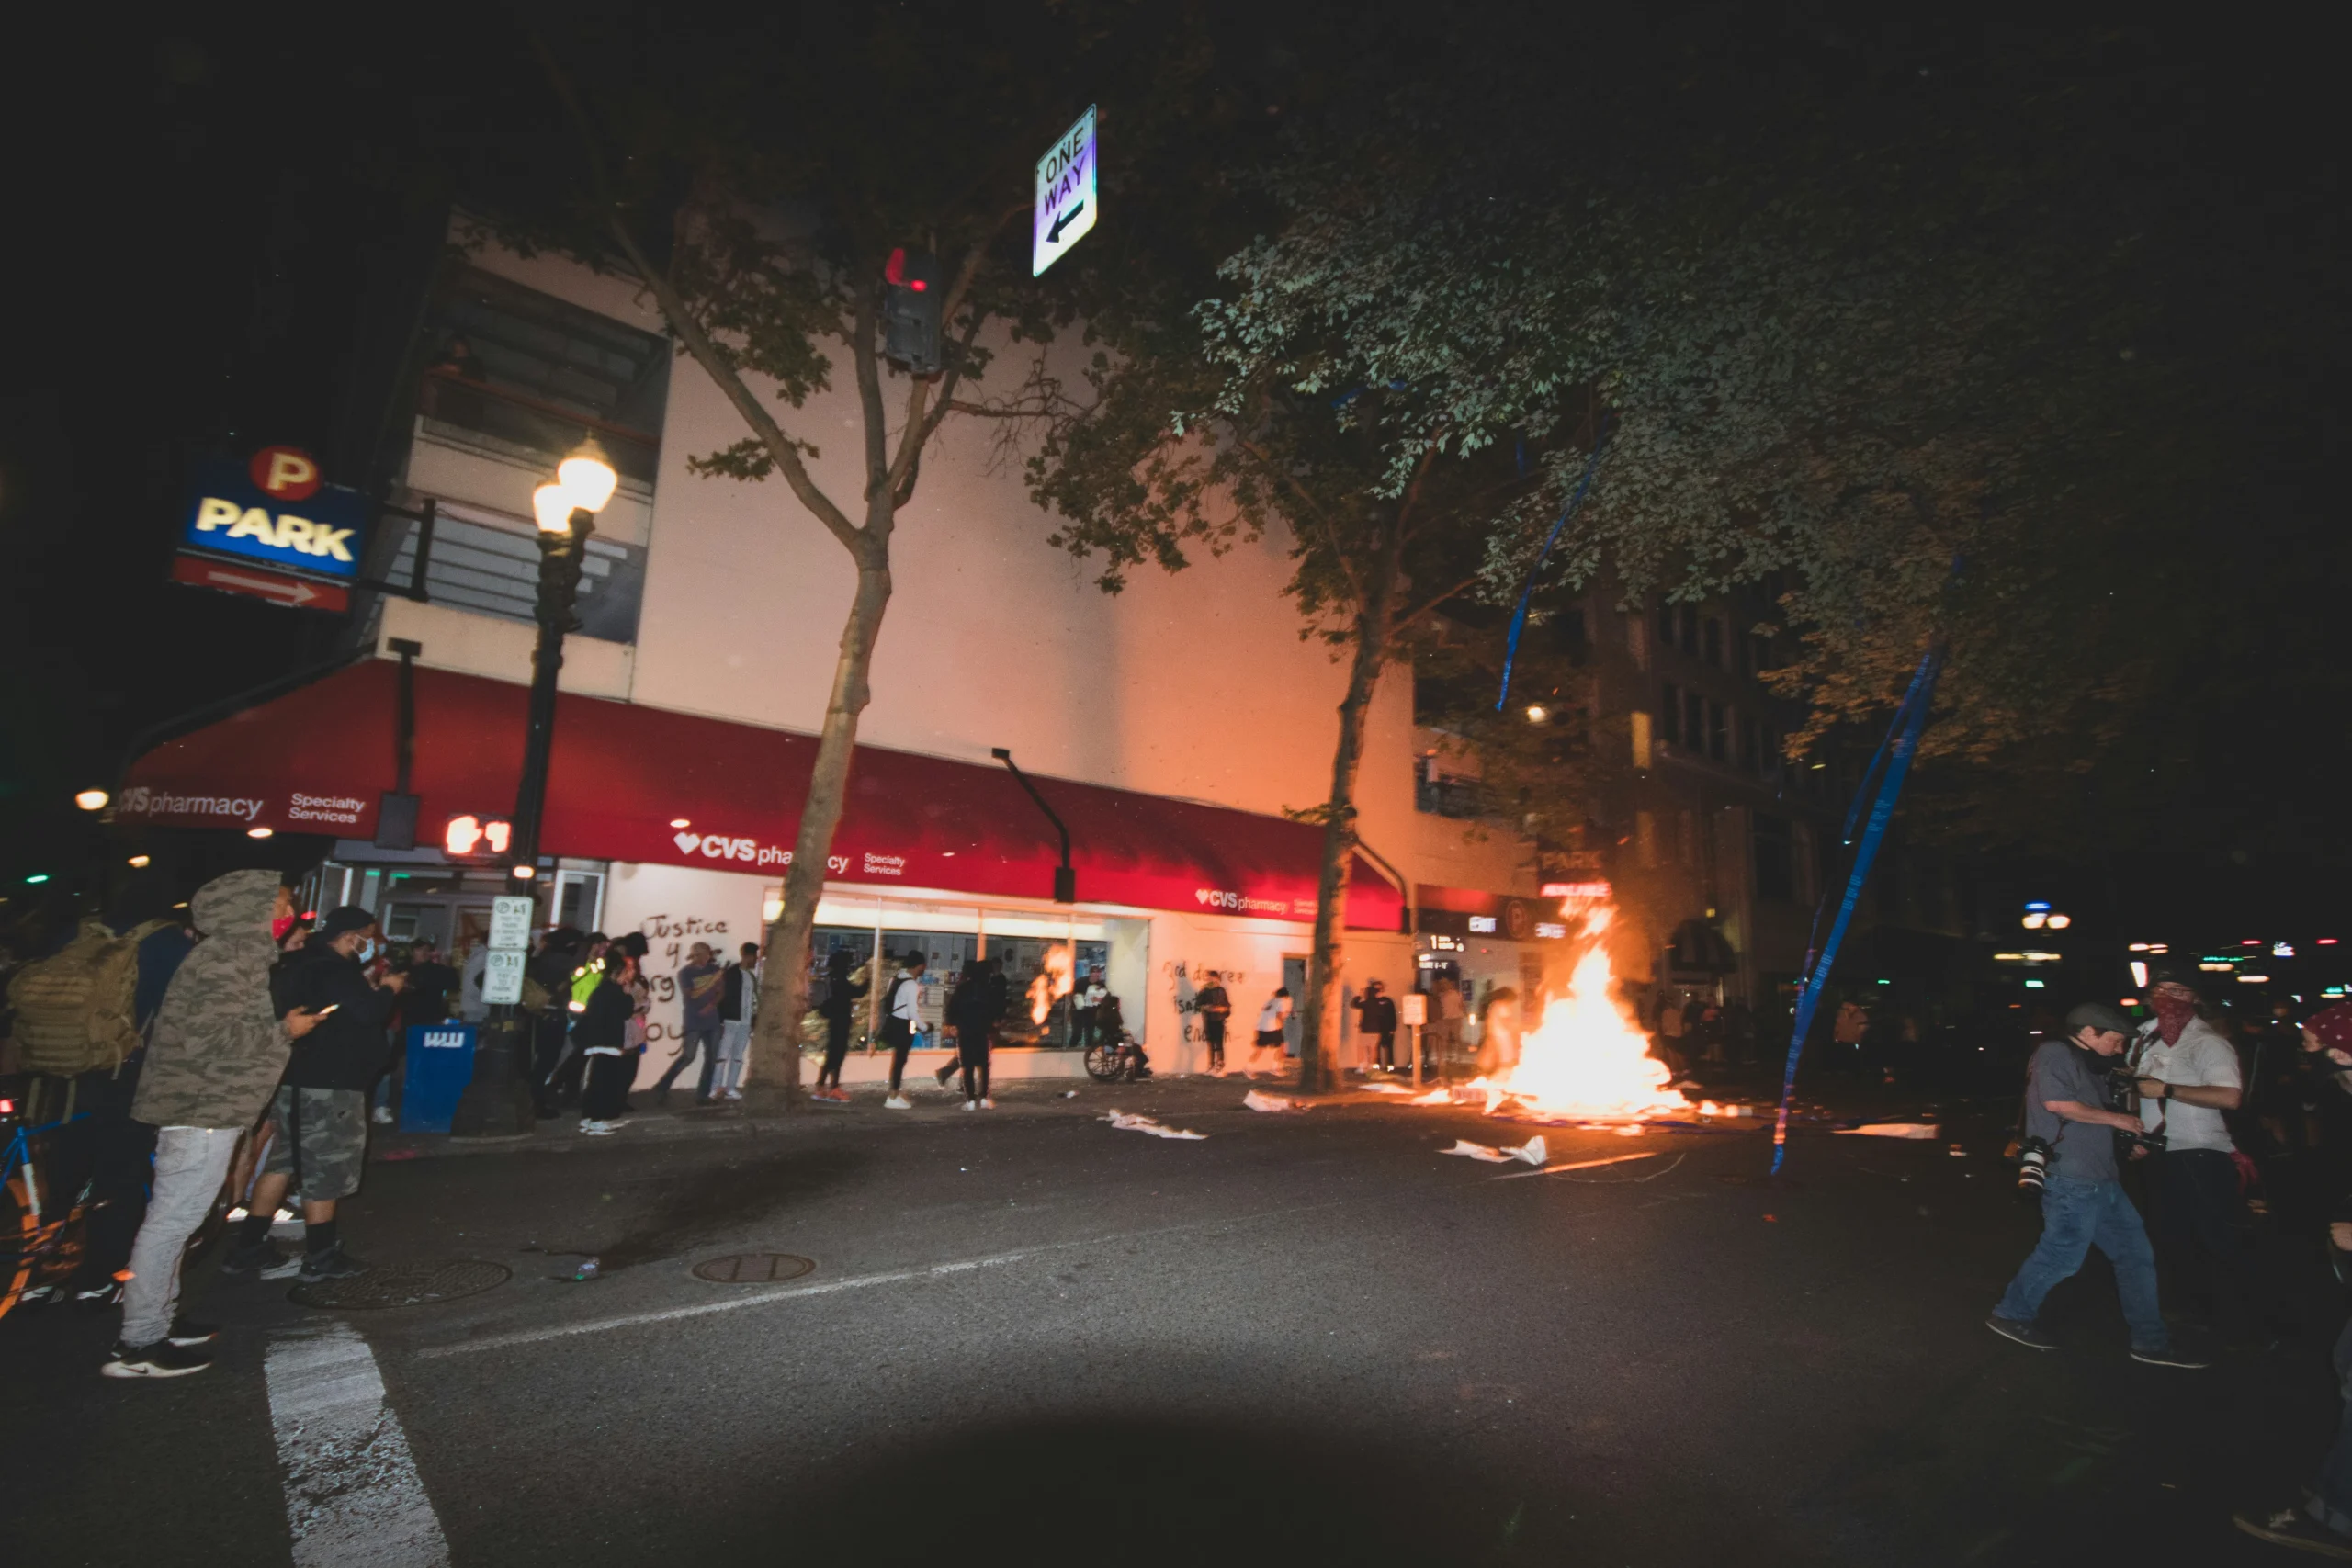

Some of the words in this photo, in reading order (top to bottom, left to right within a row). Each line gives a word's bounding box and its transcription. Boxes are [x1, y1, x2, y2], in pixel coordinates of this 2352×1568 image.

[1046, 127, 1084, 184] ONE
[1045, 154, 1085, 216] WAY
[266, 452, 318, 491] P
[195, 497, 356, 561] PARK
[150, 792, 264, 821] pharmacy
[288, 807, 357, 824] Services
[290, 793, 365, 812] Specialty
[701, 835, 756, 862] CVS
[757, 846, 849, 874] phacy
[864, 852, 905, 867] Specialty
[863, 863, 901, 876] Services
[1209, 890, 1238, 908] CVS
[1238, 897, 1287, 915] pharmacy
[645, 915, 729, 940] Justice
[1162, 961, 1187, 991] 3rd
[1193, 963, 1243, 984] deree
